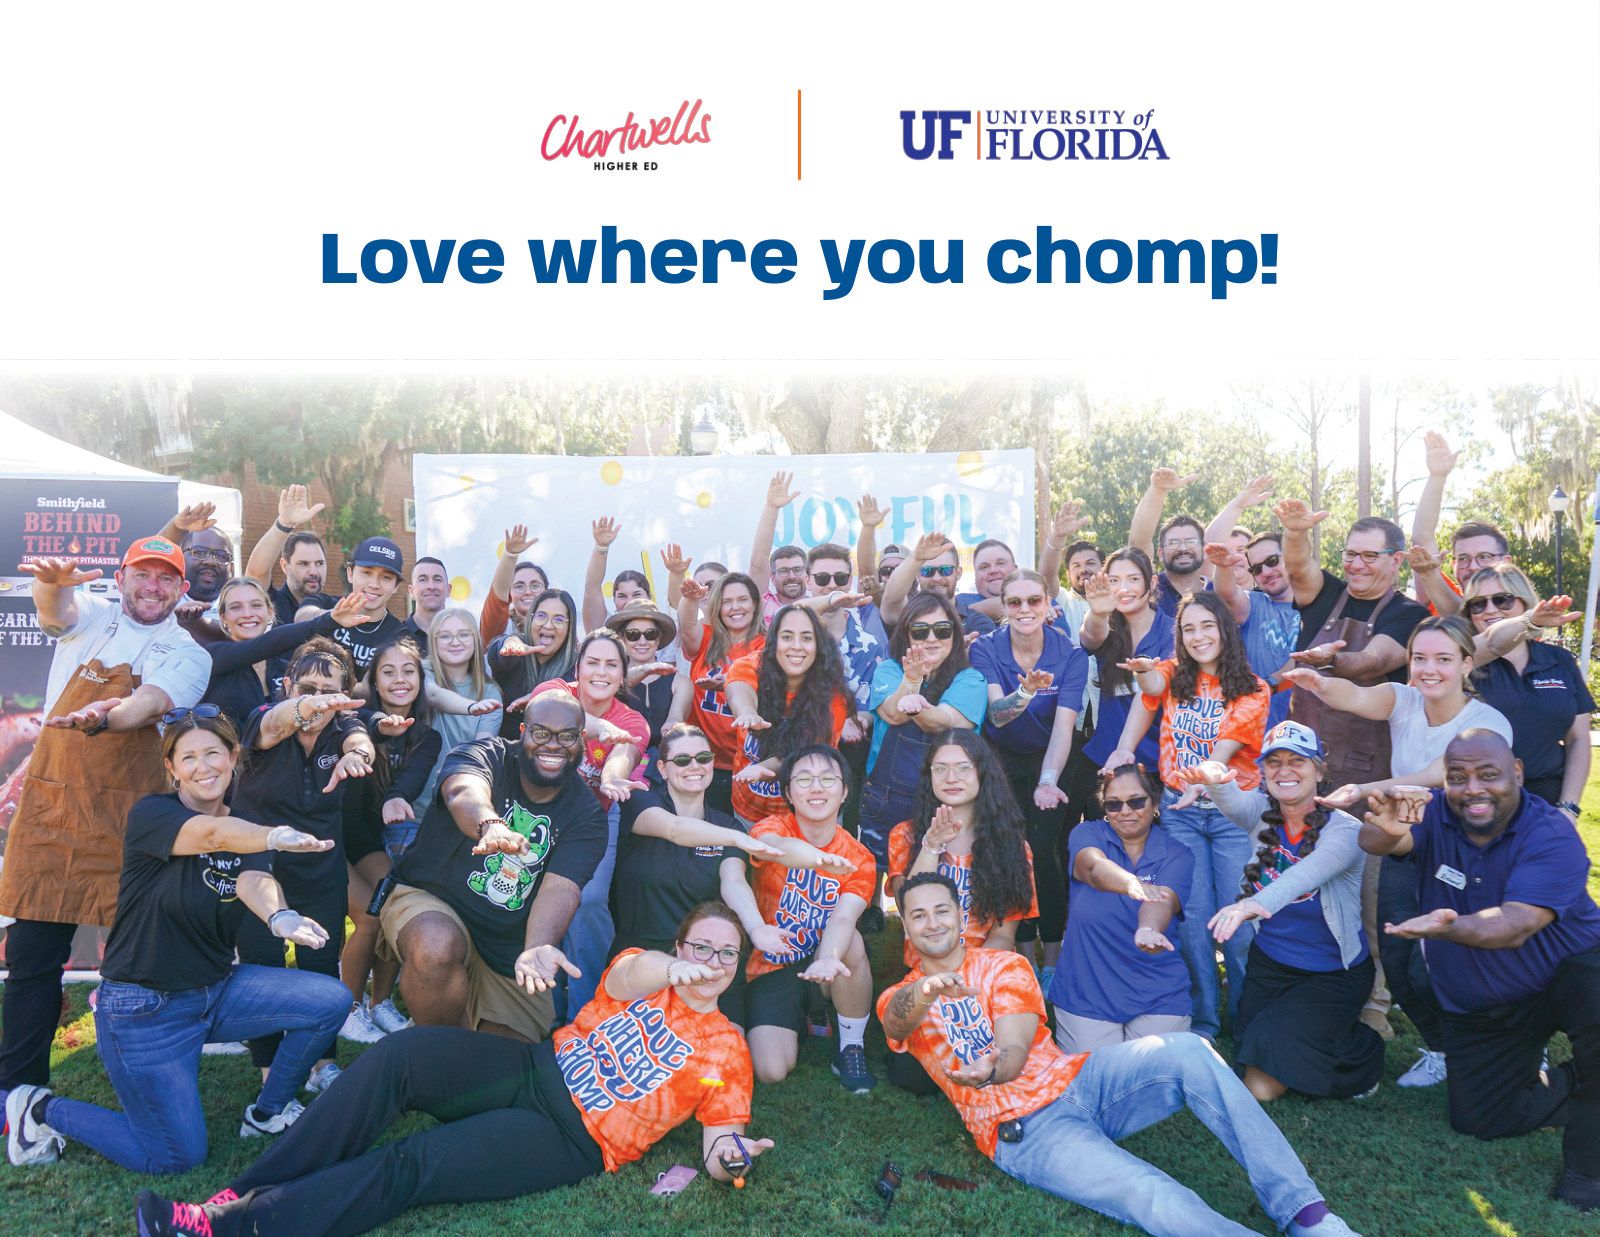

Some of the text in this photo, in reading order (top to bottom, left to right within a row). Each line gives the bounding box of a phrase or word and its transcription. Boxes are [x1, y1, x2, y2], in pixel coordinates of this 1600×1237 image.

[37, 497, 106, 512] Smithfield
[24, 512, 122, 533] BEHIND
[23, 535, 120, 554] THE PIT
[80, 556, 120, 565] PITMASTER
[9, 631, 43, 646] THE
[1172, 712, 1222, 741] WHERE
[626, 999, 695, 1070] LOVE
[596, 1012, 673, 1094] WHERE
[556, 1037, 616, 1113] CHOMP
[587, 1031, 647, 1102] YOU
